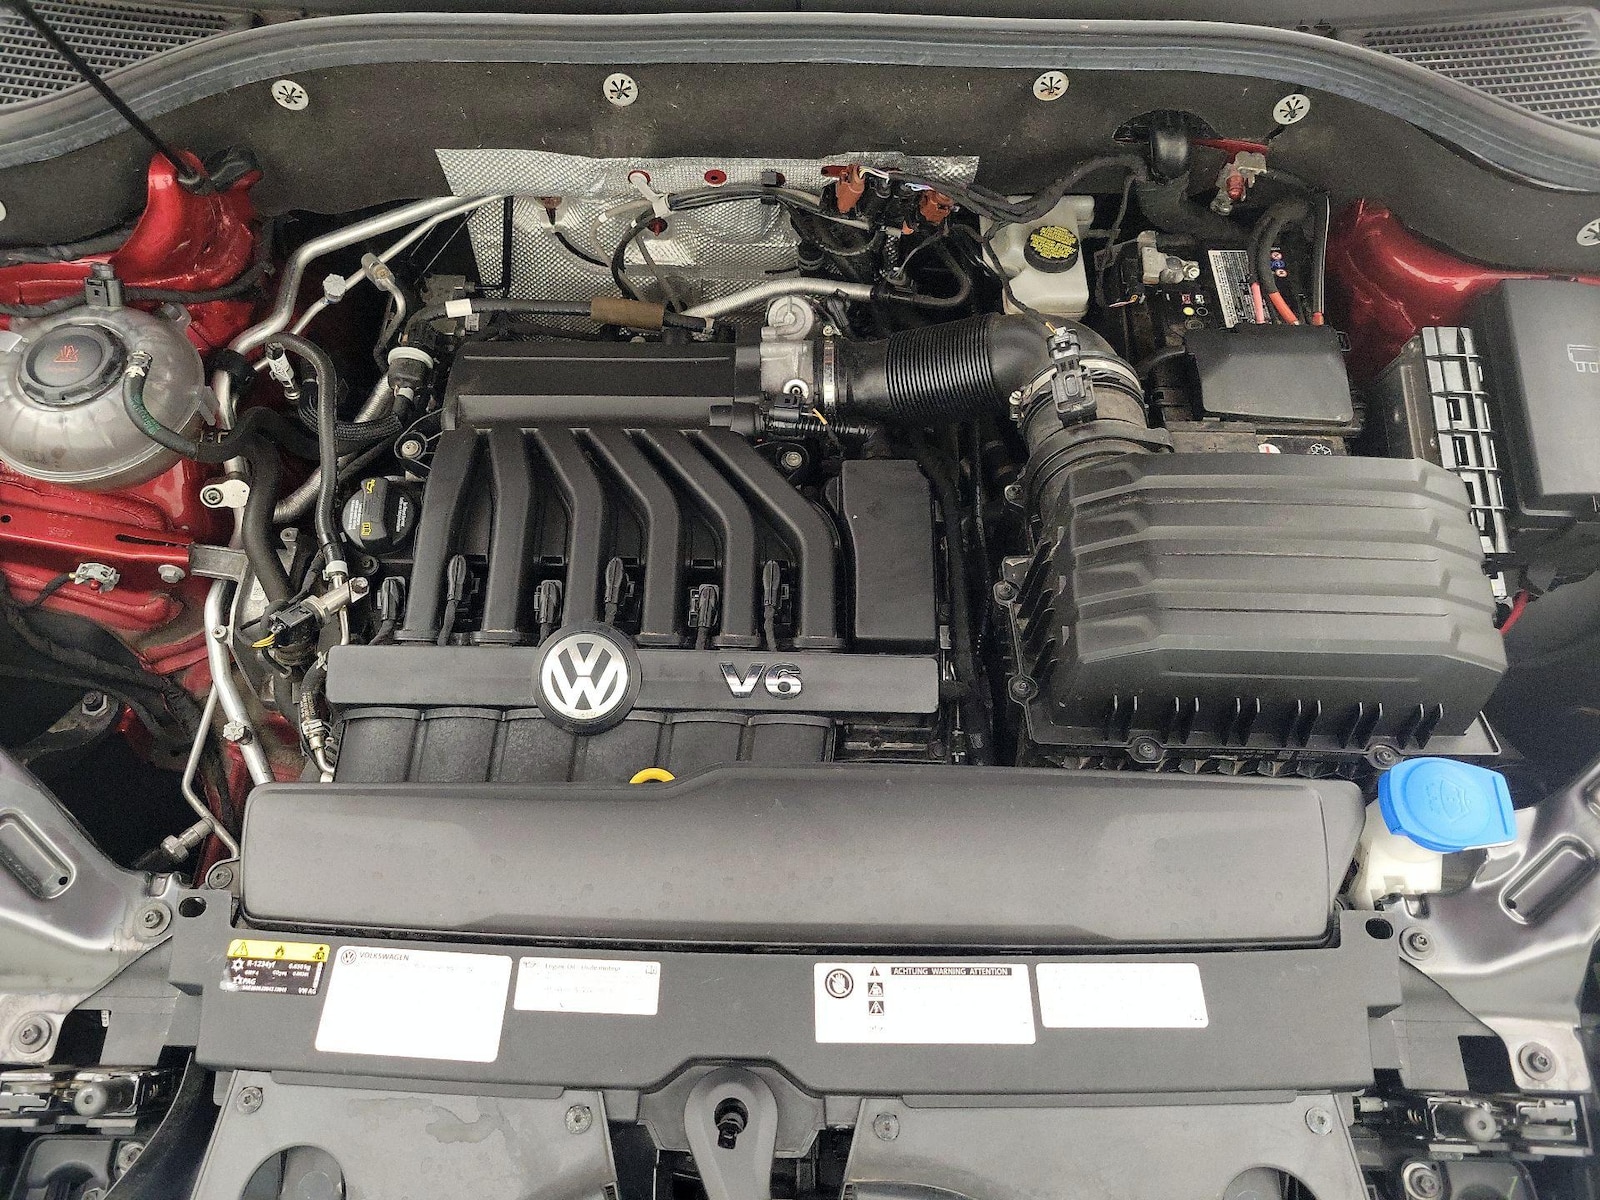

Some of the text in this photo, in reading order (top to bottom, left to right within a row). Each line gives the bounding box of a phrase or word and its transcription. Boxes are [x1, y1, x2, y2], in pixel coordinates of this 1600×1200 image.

[719, 661, 802, 699] V6
[360, 951, 410, 961] VOLKSWAGEN
[246, 960, 276, 970] R-1234yf
[893, 967, 1008, 975] ACHTUNG WARNING ATTENTION
